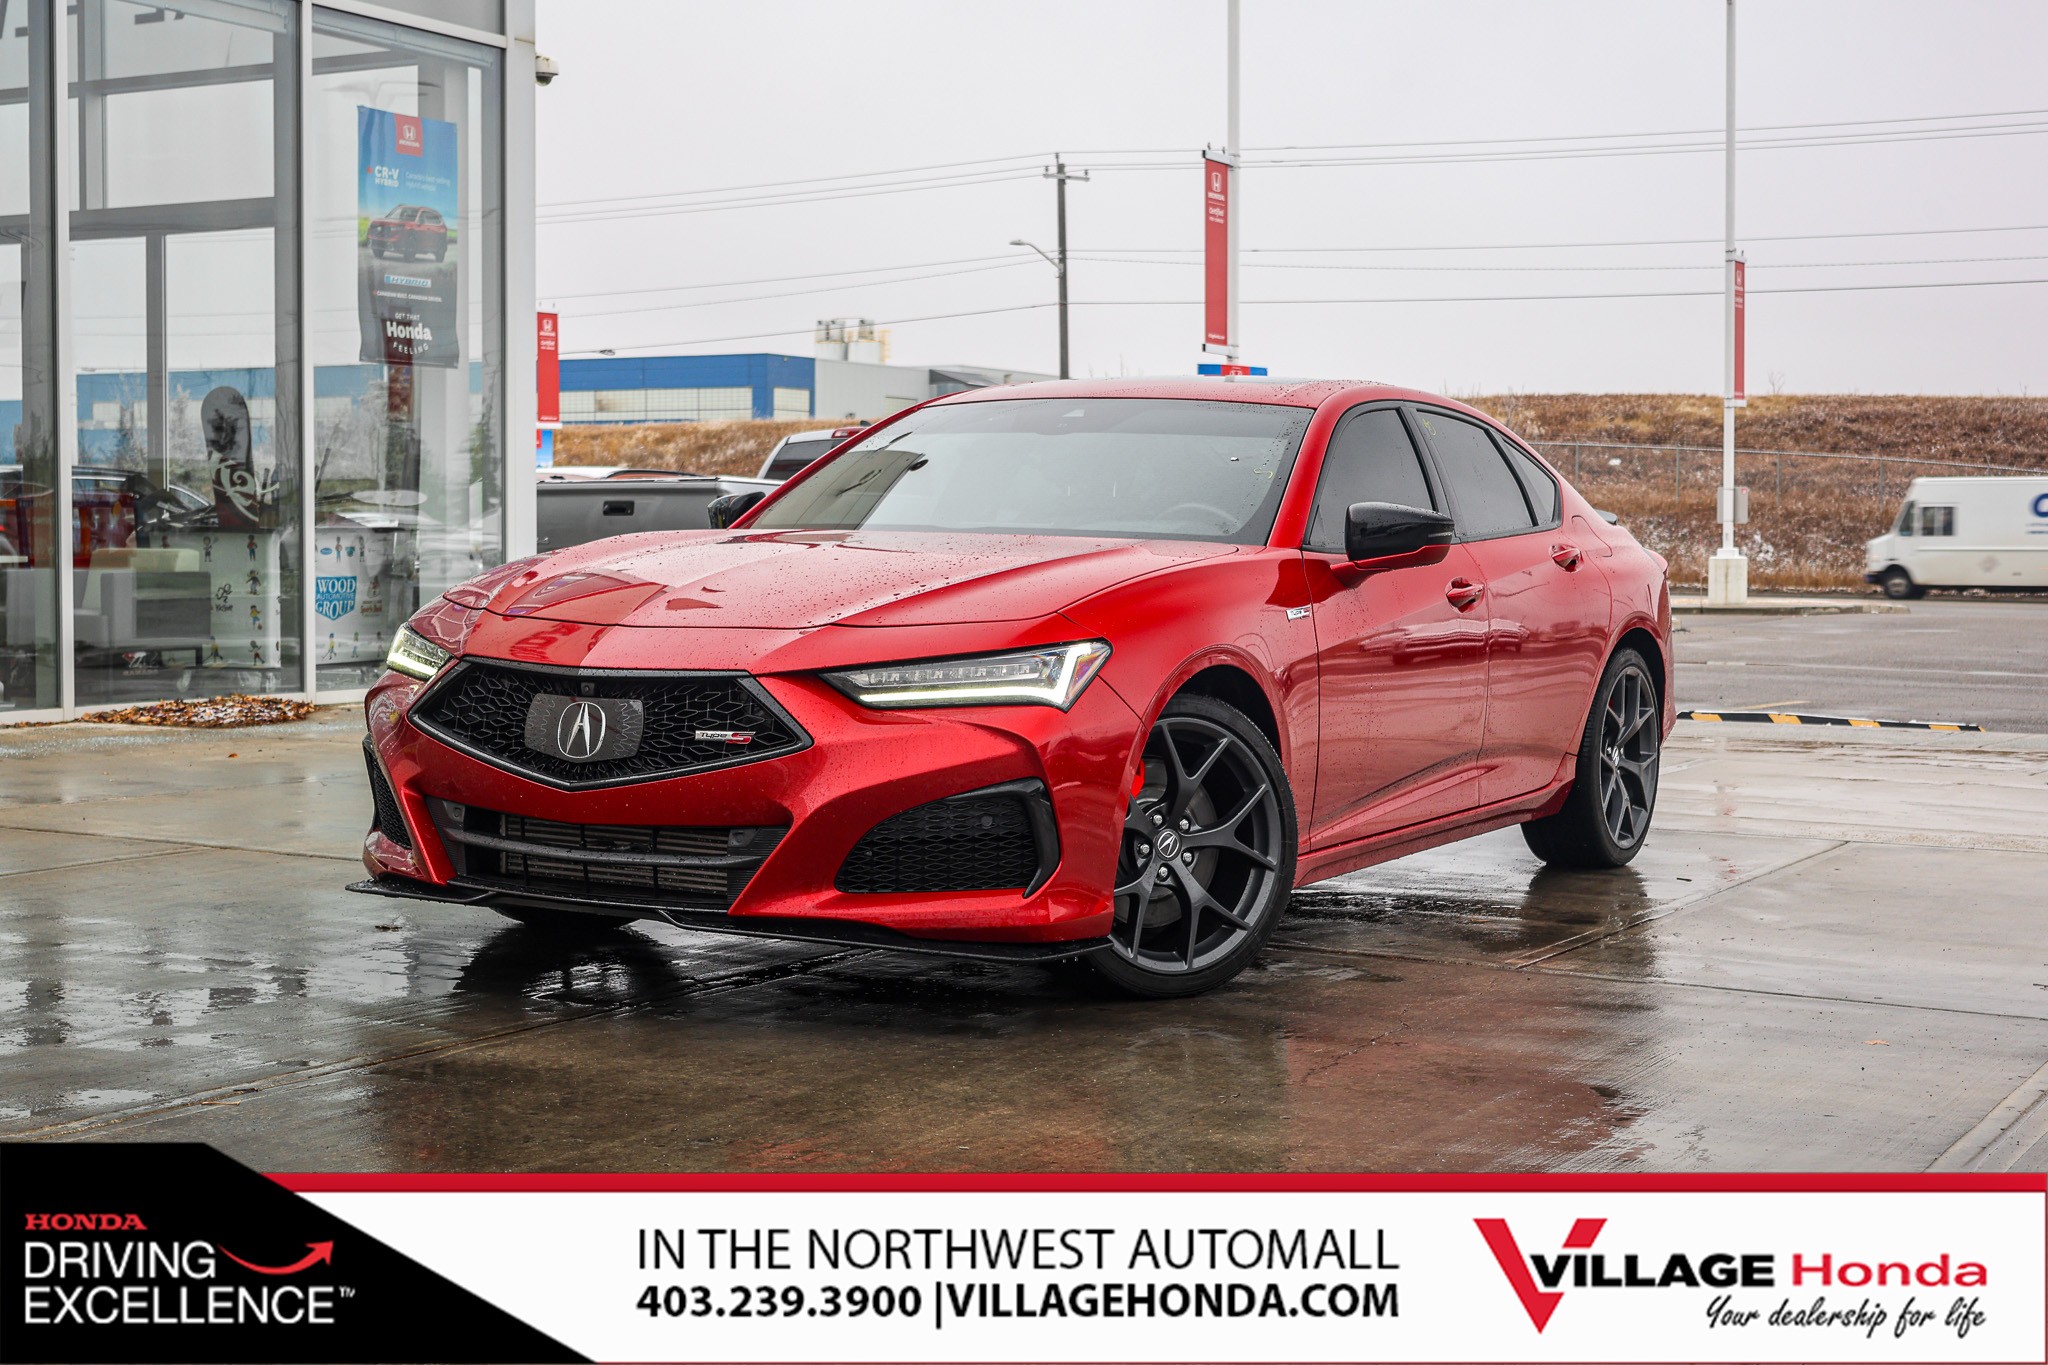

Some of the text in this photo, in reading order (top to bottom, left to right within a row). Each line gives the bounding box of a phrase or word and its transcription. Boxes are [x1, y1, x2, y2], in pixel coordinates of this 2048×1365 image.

[375, 165, 399, 180] CR-V
[395, 312, 420, 321] GET THAT
[386, 320, 432, 340] Honda
[393, 341, 429, 354] FEELING
[317, 578, 356, 594] WOOD
[315, 600, 354, 619] GROUP
